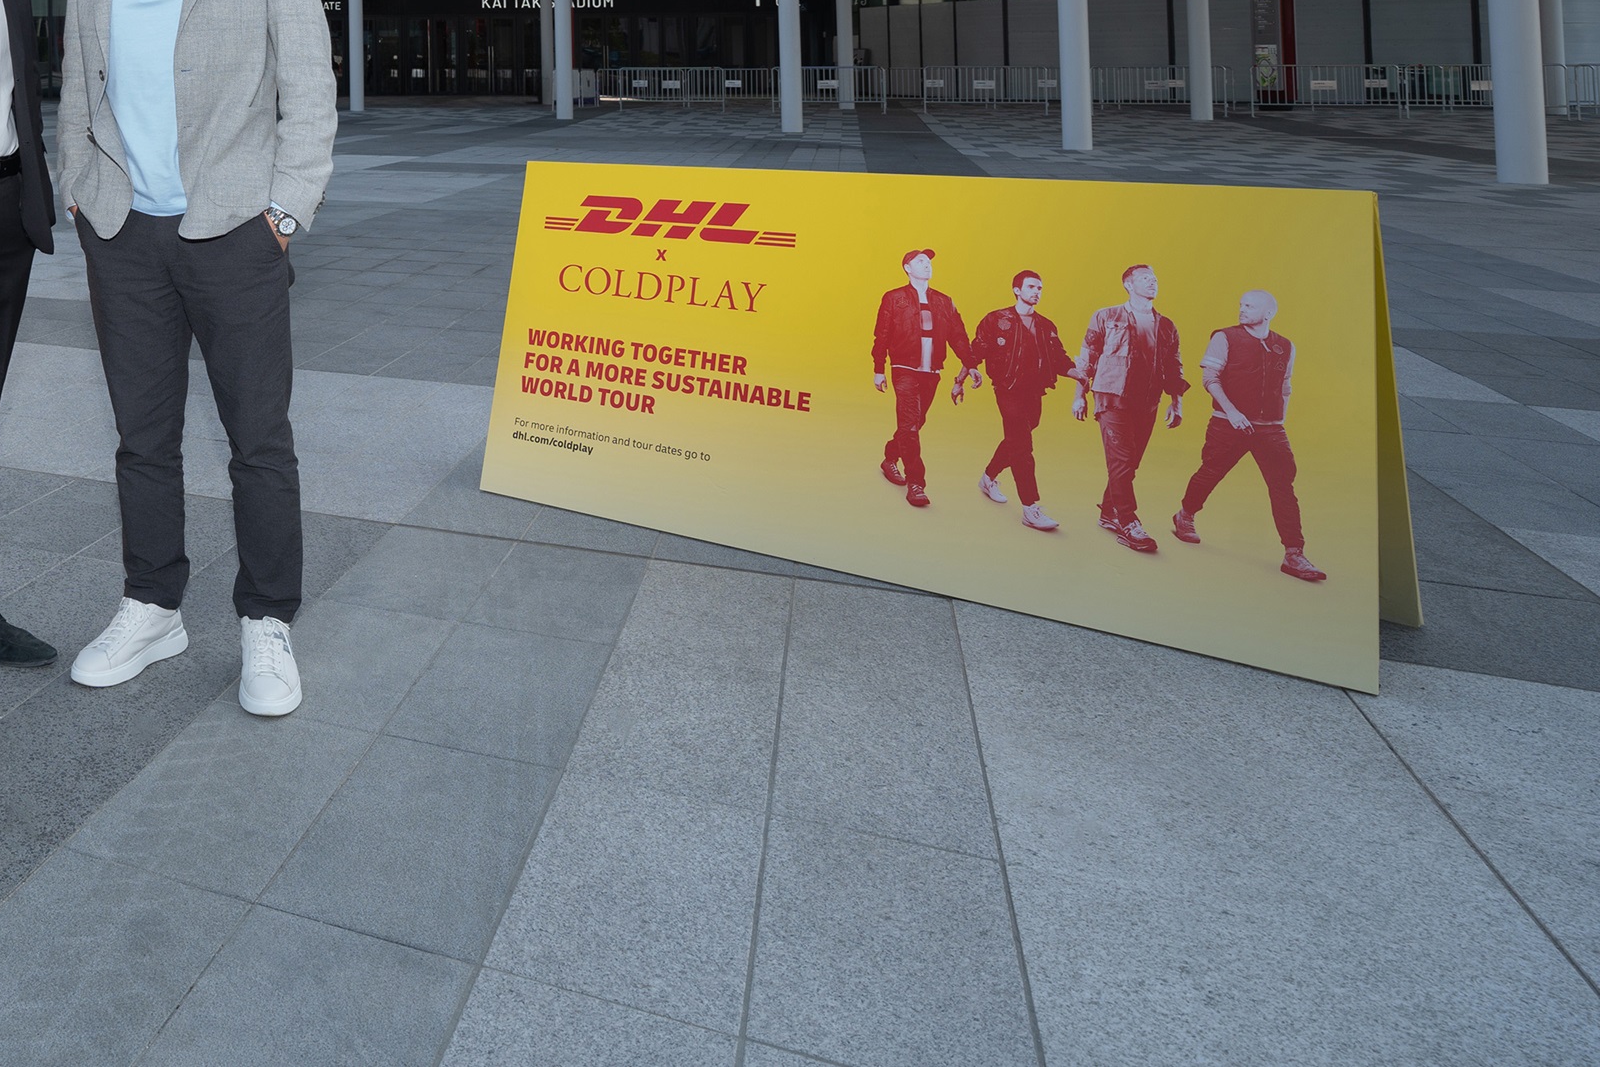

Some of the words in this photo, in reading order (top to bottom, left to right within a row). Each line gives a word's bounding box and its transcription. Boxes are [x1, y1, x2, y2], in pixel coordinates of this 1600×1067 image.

[322, 1, 342, 11] ATE
[574, 194, 760, 245] DHL
[558, 264, 768, 313] COLDPLAY
[527, 327, 626, 358] WORKING
[630, 342, 748, 376] TOGETHER
[521, 375, 593, 404] WORLD
[598, 387, 656, 415] TOUR
[523, 351, 563, 377] FOR
[566, 358, 581, 377] A
[585, 361, 647, 388] MORE
[651, 370, 812, 413] SUSTAINABLE
[512, 430, 594, 455] dhl.com/coldplay
[514, 417, 530, 427] For
[531, 421, 555, 433] more
[556, 425, 610, 443] information
[611, 436, 631, 447] and
[632, 439, 654, 451] tour
[655, 443, 683, 457] dates
[684, 450, 698, 460] go
[700, 452, 711, 462] to
